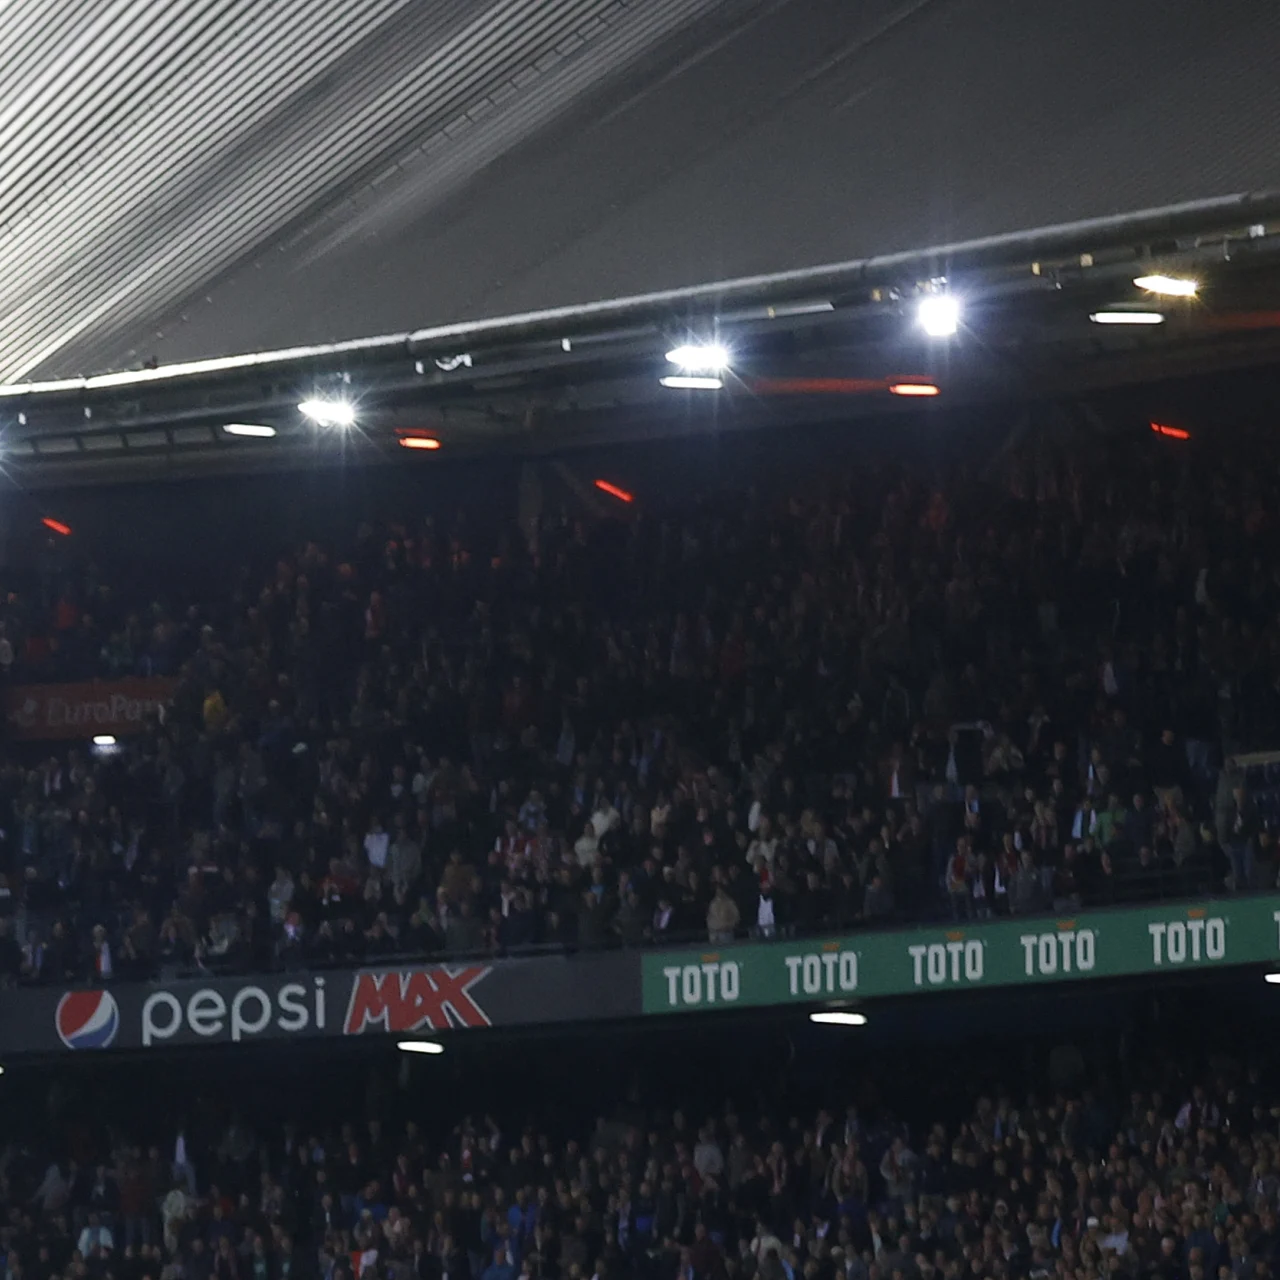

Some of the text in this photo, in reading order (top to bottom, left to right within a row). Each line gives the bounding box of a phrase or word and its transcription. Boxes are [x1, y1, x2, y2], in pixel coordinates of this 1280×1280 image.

[908, 938, 984, 986] TOTO
[1020, 928, 1096, 976] TOTO
[1148, 917, 1225, 966] TOTO
[663, 959, 739, 1006] TOTO
[784, 950, 858, 996] TOTO
[141, 965, 493, 1046] pepsi MAX
